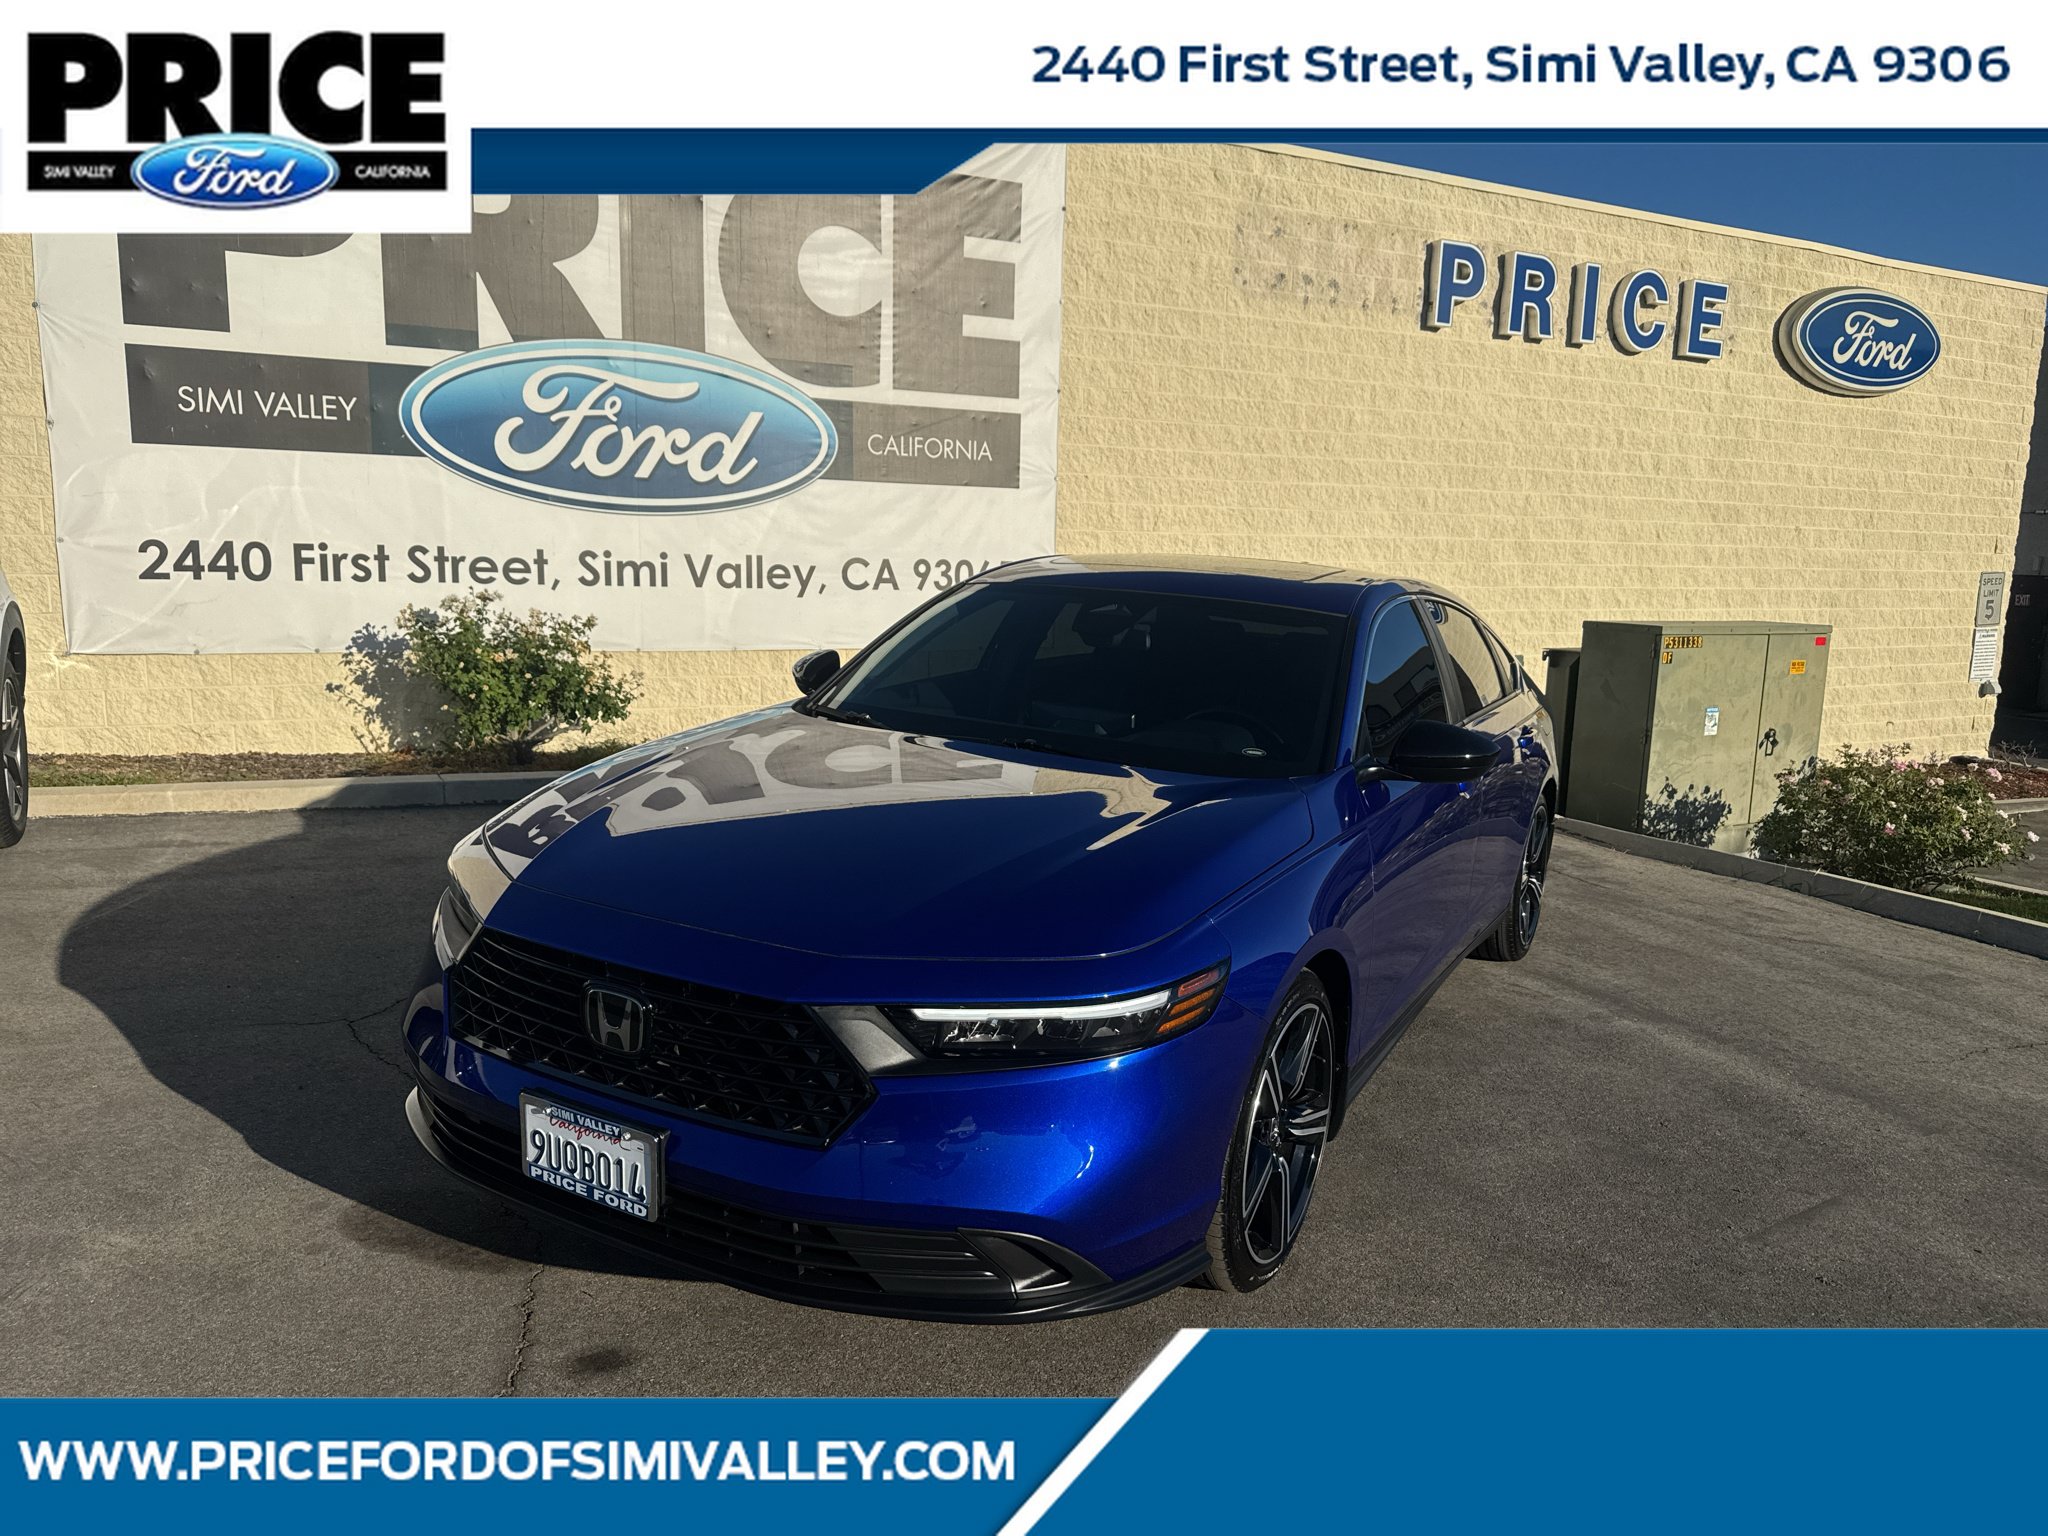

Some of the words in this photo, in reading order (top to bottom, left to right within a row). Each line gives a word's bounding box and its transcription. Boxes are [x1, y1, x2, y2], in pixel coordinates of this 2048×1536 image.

[1430, 239, 1730, 360] PRICE
[1832, 310, 1917, 371] Ford
[177, 385, 243, 415] SIMI
[254, 390, 358, 422] VALLEY
[494, 365, 765, 485] Ford
[867, 433, 993, 462] CALIFORNIA
[138, 539, 272, 582] 2440
[293, 542, 390, 583] First
[407, 544, 561, 592] Street,
[577, 549, 668, 588] Simi
[684, 553, 827, 598] Valley,
[841, 557, 900, 591] CA
[913, 558, 1013, 591] 930
[1982, 577, 2002, 586] SPEED
[1983, 589, 1999, 598] LIMIT
[1984, 599, 1995, 620] 5
[2015, 594, 2031, 606] EXIT
[551, 1106, 575, 1122] SIMI
[576, 1114, 621, 1137] VALLEY
[530, 1128, 647, 1204] 9UQB014
[530, 1165, 588, 1196] PRICE
[593, 1189, 648, 1218] FORD
